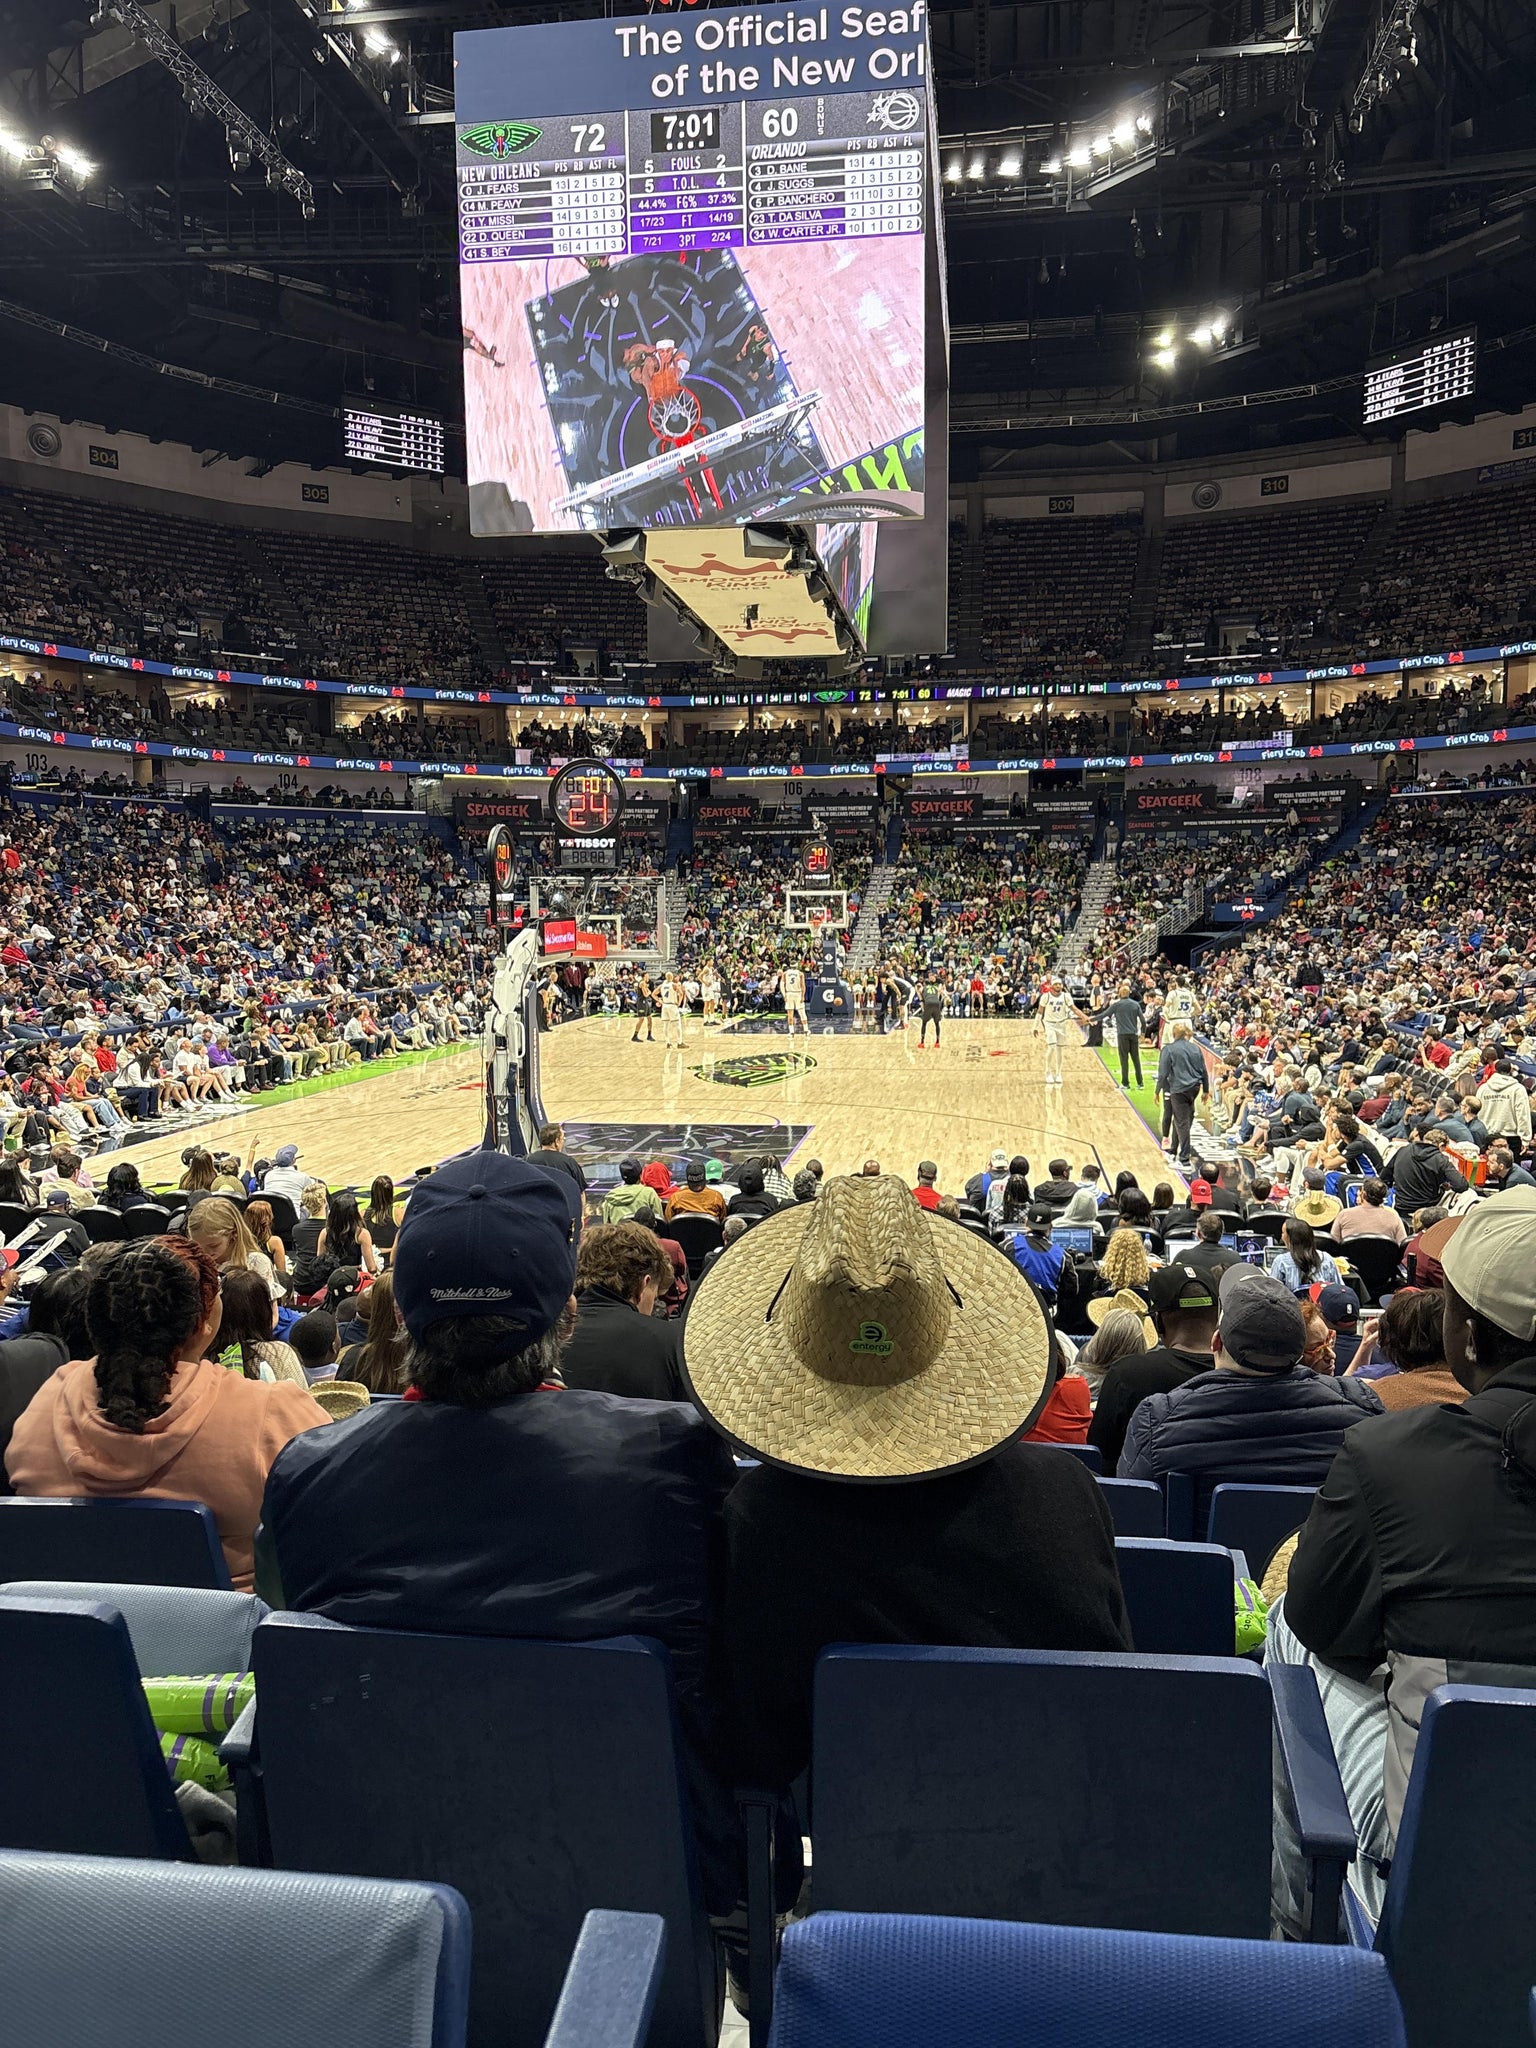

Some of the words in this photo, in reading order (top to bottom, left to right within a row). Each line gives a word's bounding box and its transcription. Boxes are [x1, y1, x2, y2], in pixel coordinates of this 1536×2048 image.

[615, 24, 682, 57] The
[695, 8, 827, 50] Official
[841, 1, 925, 38] Seaf
[651, 64, 689, 98] of
[700, 61, 760, 94] the
[772, 56, 856, 88] New
[868, 44, 924, 80] Orl
[762, 108, 798, 138] 60
[816, 98, 825, 135] BONUS
[663, 112, 714, 140] 7:01
[570, 123, 606, 152] 72
[847, 140, 861, 150] PTS
[867, 139, 878, 149] RB
[883, 138, 898, 148] AST
[903, 136, 912, 146] FL
[751, 142, 807, 160] ORLANDO
[554, 162, 568, 172] PTS
[573, 160, 584, 171] RB
[588, 159, 602, 170] AST
[608, 158, 617, 169] FL
[644, 159, 654, 174] 5
[671, 156, 702, 170] FOULS
[716, 154, 726, 168] 2
[849, 159, 860, 168] 13
[869, 157, 876, 166] 4
[888, 156, 894, 164] 3
[906, 154, 913, 164] 2
[462, 166, 486, 182] NEW
[490, 162, 540, 180] ORLEANS
[755, 166, 761, 176] 3
[767, 165, 778, 175] D.
[780, 163, 808, 174] BANE
[466, 185, 472, 195] 0
[477, 184, 485, 194] J.
[487, 184, 520, 194] FEARS
[556, 180, 566, 190] 13
[574, 180, 580, 188] 2
[592, 178, 598, 187] 5
[609, 177, 615, 186] 2
[644, 178, 654, 193] 5
[672, 176, 700, 190] T.O.L.
[716, 172, 726, 188] 4
[754, 182, 762, 191] 4
[767, 181, 776, 190] J.
[778, 178, 815, 190] SUGGS
[558, 196, 564, 204] 3
[574, 195, 580, 204] 4
[592, 194, 598, 202] 0
[610, 192, 616, 202] 2
[638, 198, 667, 210] 44.4%
[676, 195, 698, 208] FG%
[708, 193, 736, 204] 37.3%
[755, 198, 762, 208] 5
[767, 197, 776, 206] P.
[778, 194, 835, 205] BANCHERO
[850, 191, 860, 200] 11
[464, 202, 475, 212] 14
[478, 202, 488, 211] M.
[491, 200, 522, 210] PEAVY
[556, 212, 567, 220] 14
[574, 211, 581, 220] 9
[592, 210, 598, 218] 3
[610, 208, 616, 217] 3
[640, 216, 664, 227] 17/23
[682, 214, 693, 227] FT
[708, 212, 734, 223] 14/19
[754, 214, 765, 224] 23
[768, 214, 776, 223] T.
[778, 212, 794, 222] DA
[794, 210, 822, 221] SILVA
[466, 218, 476, 227] 21
[478, 217, 487, 226] Y.
[488, 216, 515, 226] MISSI
[849, 223, 860, 232] 10
[466, 234, 477, 243] 22
[480, 232, 490, 242] D.
[492, 230, 526, 240] QUEEN
[559, 228, 565, 236] 0
[754, 230, 765, 240] 34
[768, 229, 780, 239] W.
[783, 226, 824, 238] CARTER
[826, 224, 842, 234] JR.
[643, 236, 662, 246] 7/21
[678, 234, 696, 248] 3PT
[711, 232, 732, 242] 2/24
[466, 250, 476, 258] 41
[480, 248, 490, 258] S.
[492, 246, 511, 256] BEY
[558, 243, 568, 252] 16
[1518, 430, 1536, 445] 31
[90, 450, 118, 466] 304
[1264, 478, 1288, 493] 310
[302, 487, 329, 500] 305
[1050, 498, 1074, 512] 309
[0, 634, 19, 649] Fiery
[20, 639, 40, 654] Crab
[1399, 656, 1422, 670] Fiery
[1422, 656, 1445, 666] Crab
[172, 664, 192, 677] Fiery
[194, 668, 214, 680] Crab
[1306, 668, 1326, 680] Fiery
[1328, 666, 1348, 677] Crab
[347, 682, 366, 694] Fiery
[368, 684, 388, 697] Crab
[1121, 682, 1142, 693] Fiery
[1142, 680, 1163, 691] Crab
[858, 690, 872, 700] 72
[892, 690, 909, 699] 7:01
[918, 689, 930, 699] 60
[946, 688, 972, 698] MAGIC
[172, 744, 190, 757] Fiery
[192, 748, 209, 760] Crab
[1351, 742, 1372, 754] Fiery
[1374, 740, 1396, 752] Crab
[25, 752, 48, 772] 103
[336, 757, 354, 769] Fiery
[356, 760, 376, 771] Crab
[1084, 758, 1104, 768] Fiery
[1106, 756, 1126, 768] Crab
[278, 772, 299, 790] 104
[961, 778, 980, 791] 107
[784, 782, 803, 796] 106
[911, 800, 974, 814] SEATGEEK
[1138, 793, 1204, 809] SEATGEEK
[466, 802, 530, 818] SEATGEEK
[569, 794, 607, 826] 24
[700, 806, 751, 818] SEATGEEK
[574, 838, 616, 848] TISSOT
[808, 856, 827, 870] 24
[822, 988, 835, 1003] G
[430, 1288, 476, 1298] Mitchell
[476, 1288, 486, 1298] &
[485, 1286, 512, 1298] Ness
[852, 1343, 891, 1352] entergy
